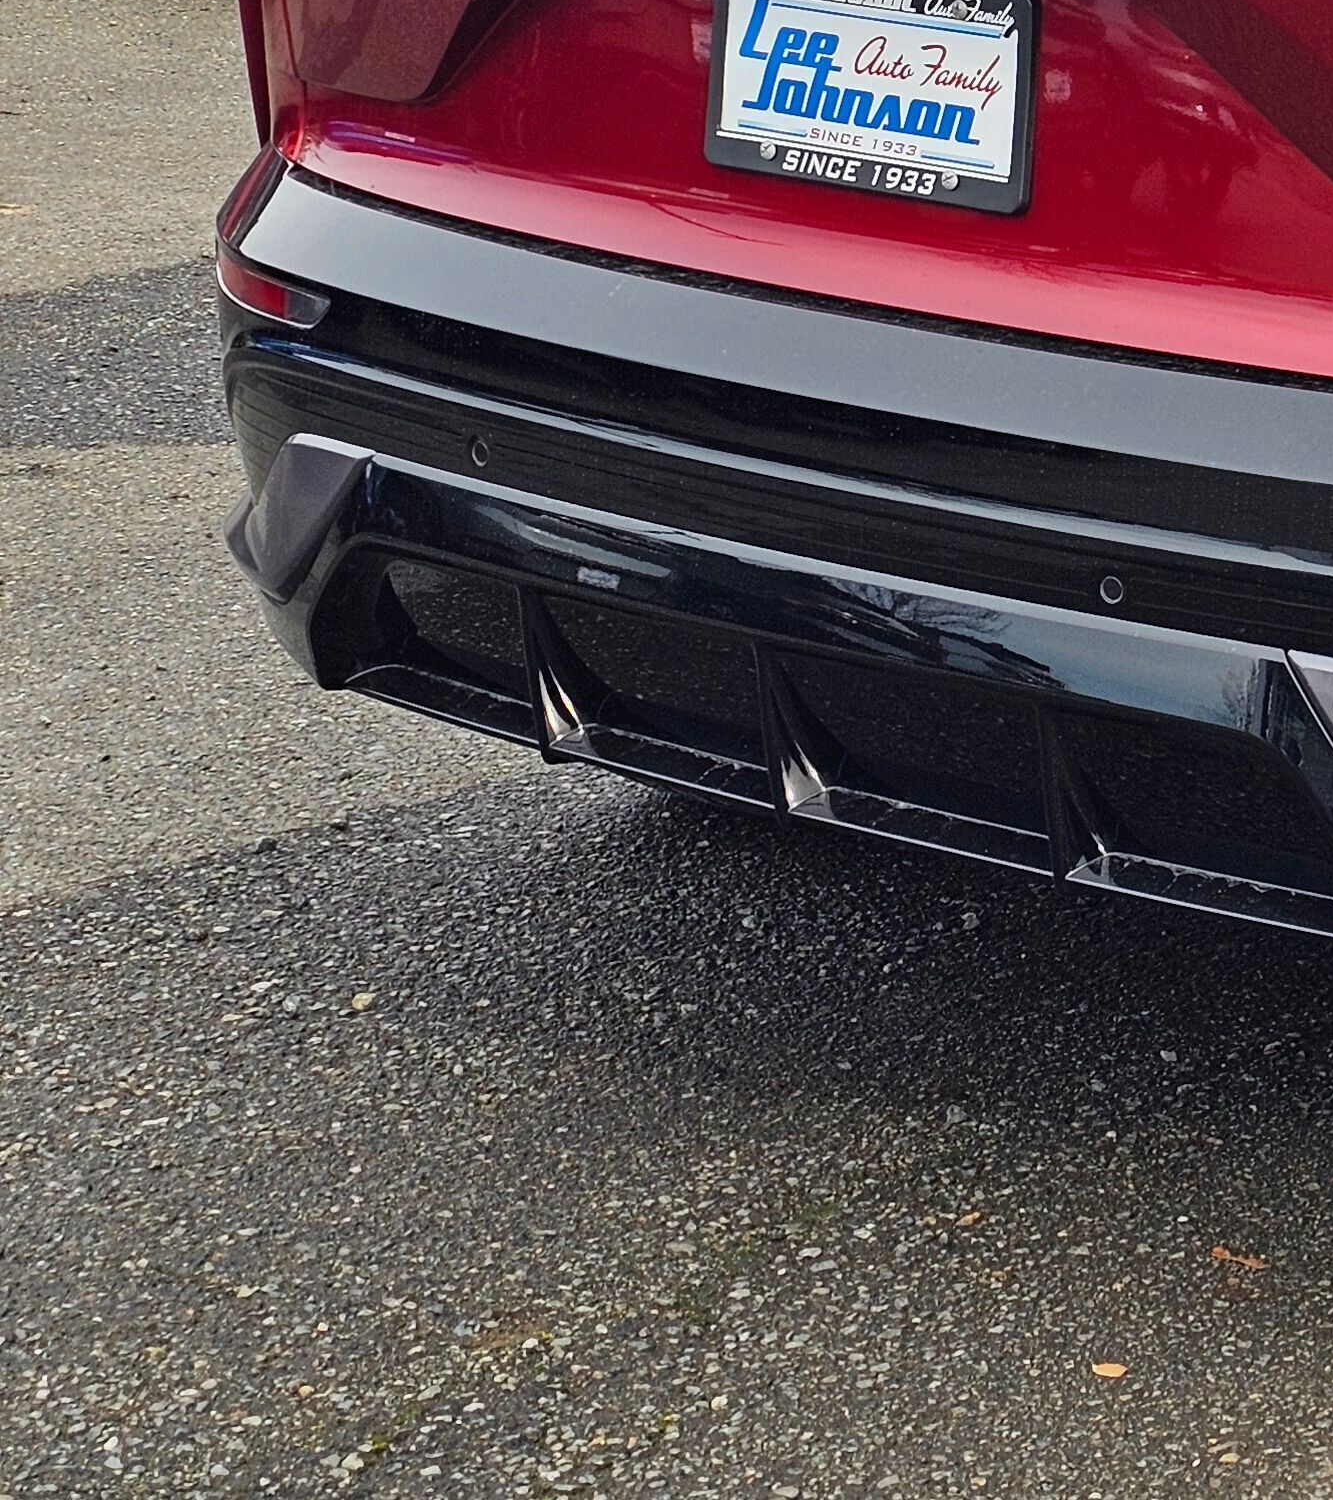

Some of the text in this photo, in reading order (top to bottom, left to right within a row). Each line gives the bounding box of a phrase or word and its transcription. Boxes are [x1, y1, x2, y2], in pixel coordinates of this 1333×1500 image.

[742, 56, 980, 146] Johnson
[854, 36, 1003, 112] Auto Family
[782, 149, 937, 197] SINCE 1933
[808, 127, 919, 157] SINCE 1933
